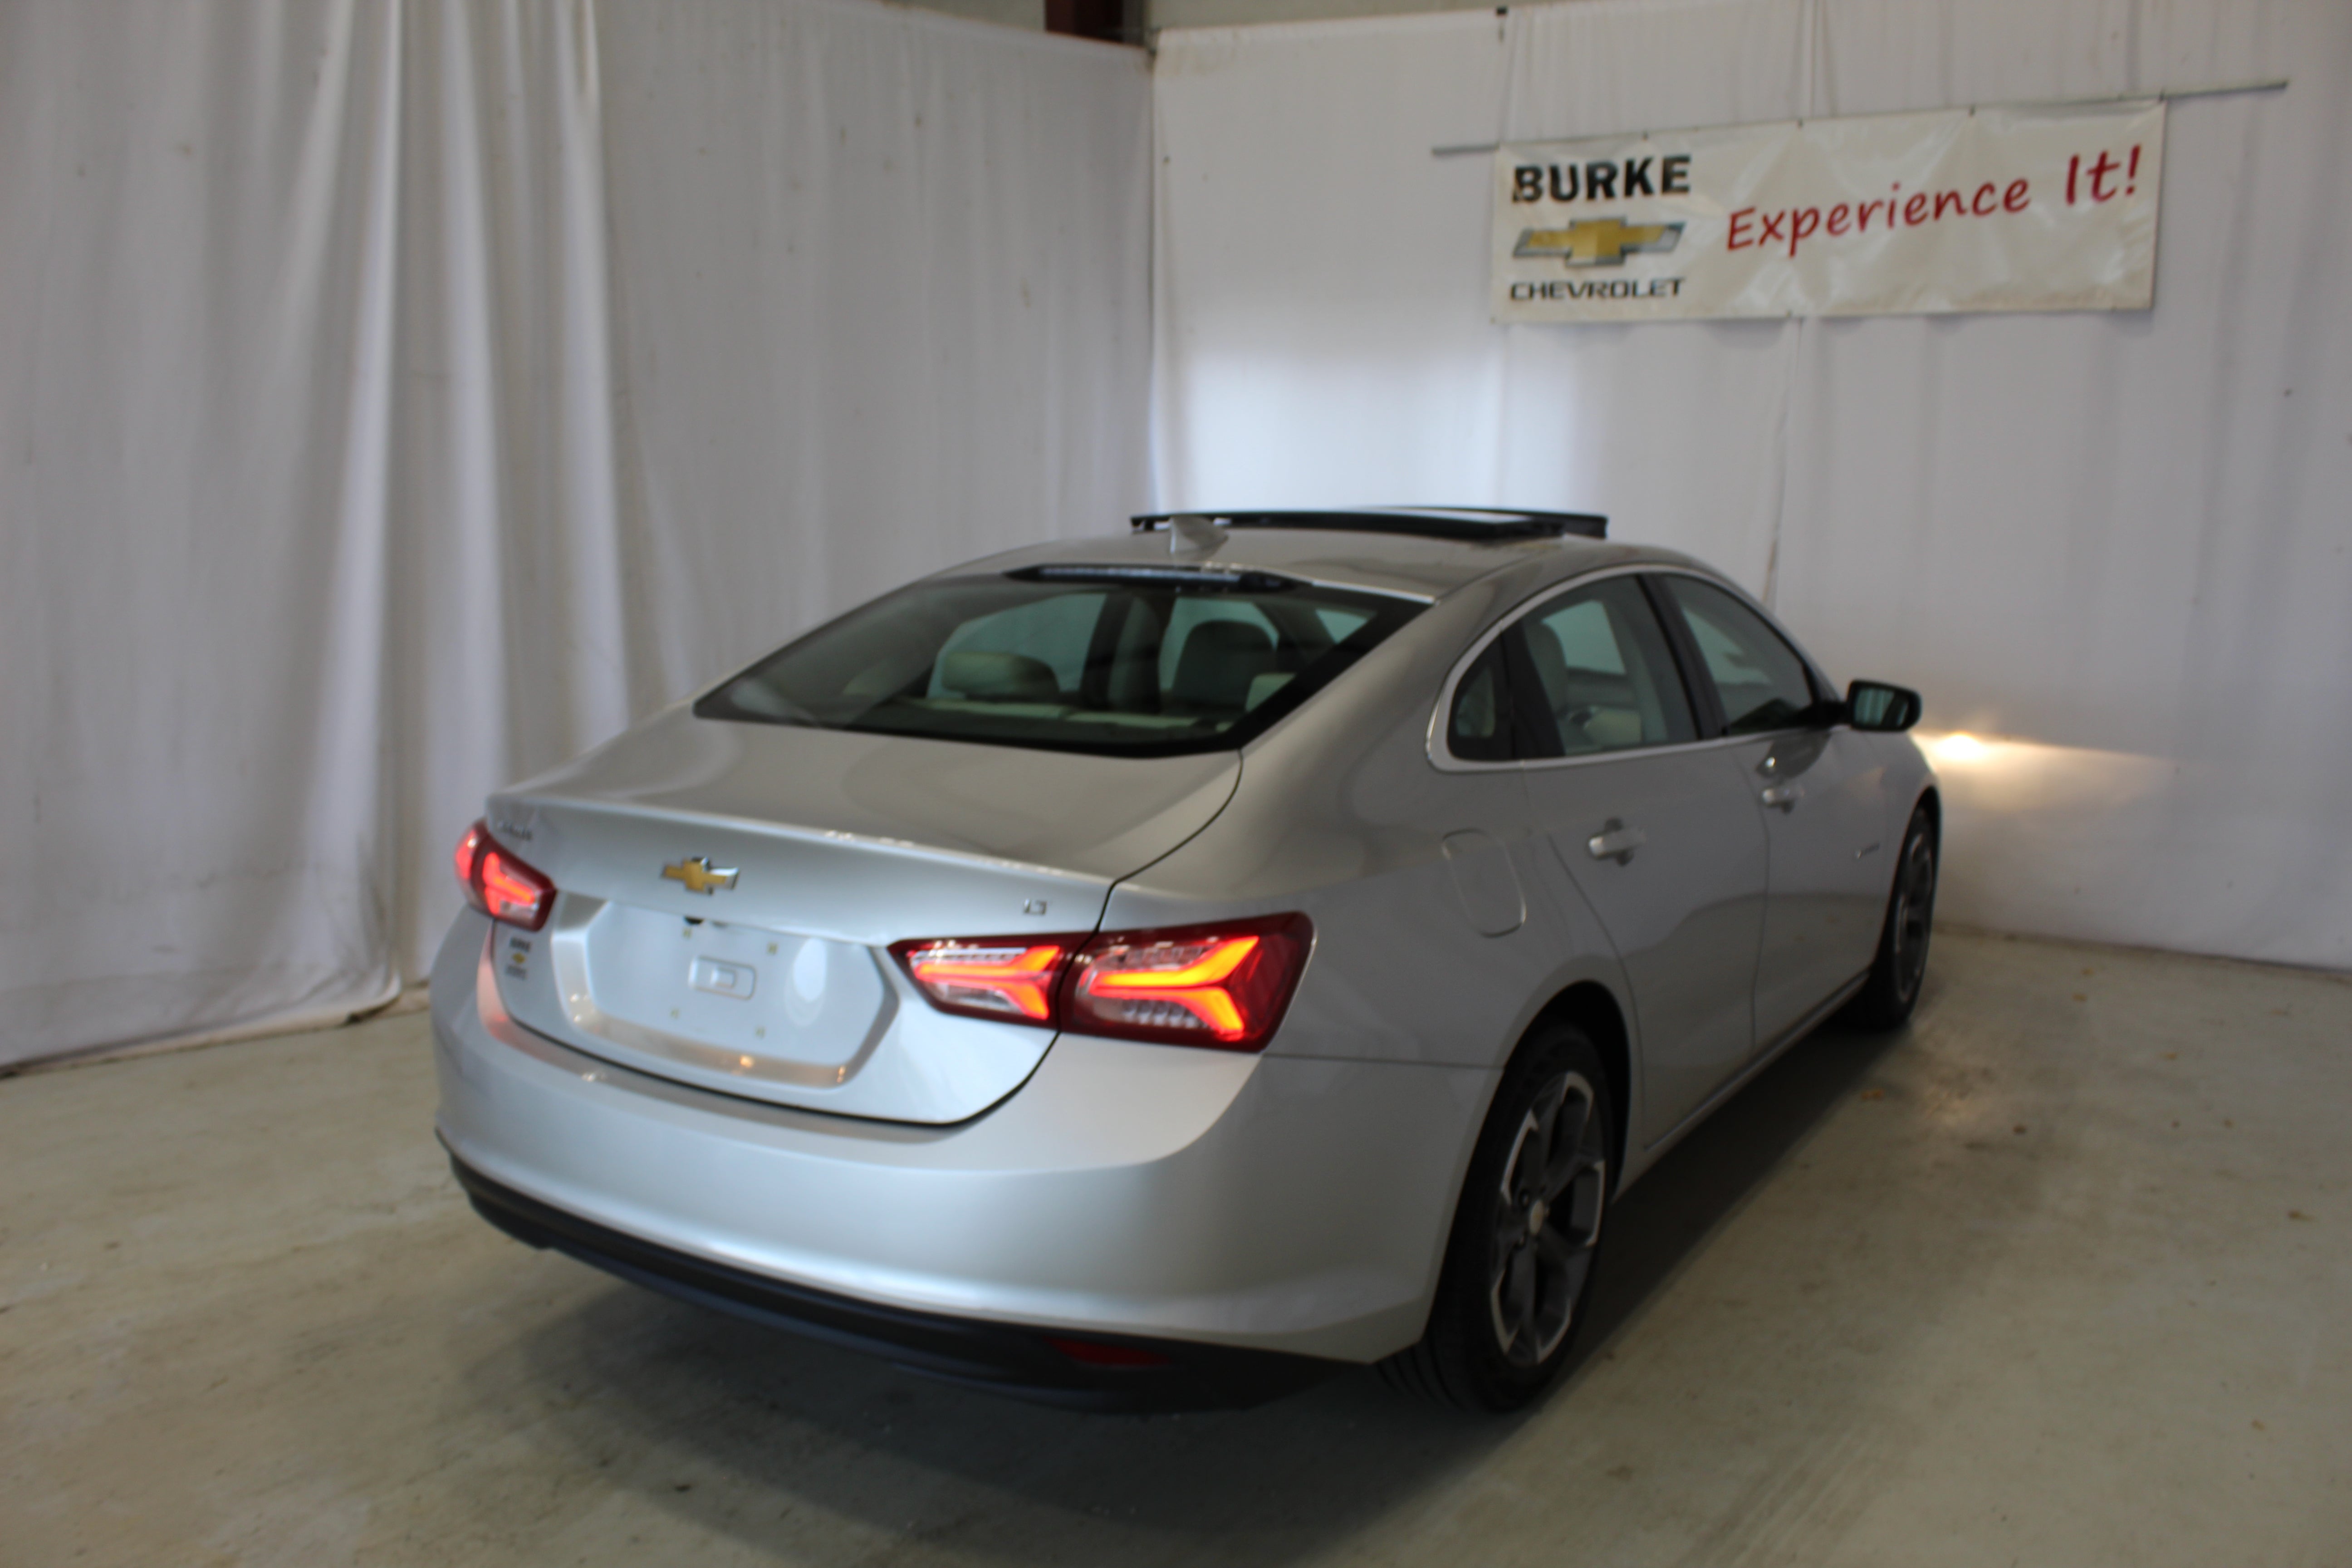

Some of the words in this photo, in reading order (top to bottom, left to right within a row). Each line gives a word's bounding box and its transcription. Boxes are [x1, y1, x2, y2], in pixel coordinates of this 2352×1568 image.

[1511, 154, 1691, 204] BURKE
[1725, 179, 2030, 259] Experience
[2064, 143, 2142, 206] It!
[1509, 276, 1686, 300] CHEVROLET
